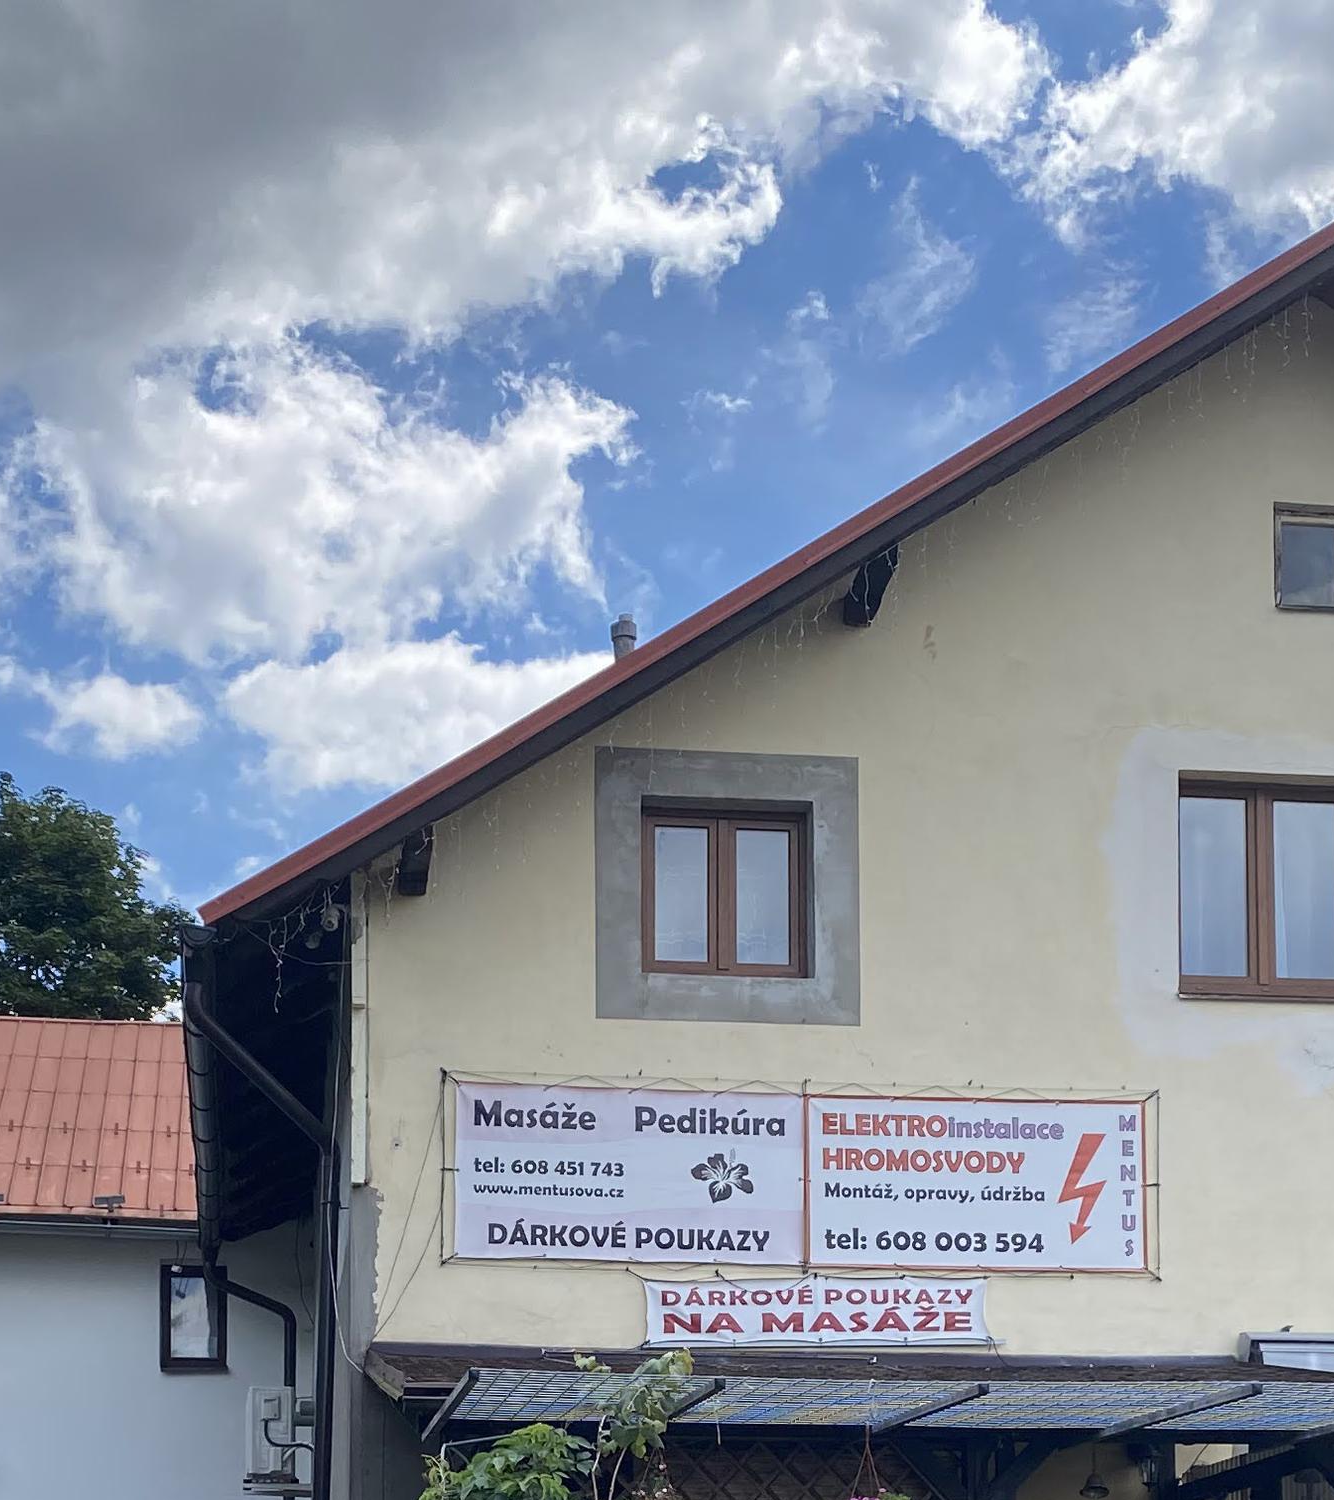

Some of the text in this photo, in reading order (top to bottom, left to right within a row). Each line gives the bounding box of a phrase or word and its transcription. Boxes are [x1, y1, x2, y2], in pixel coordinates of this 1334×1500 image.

[473, 1099, 786, 1137] Masáže Pedikúra
[822, 1112, 1064, 1140] ELEKTROinstalace
[473, 1157, 624, 1177] tel: 608 451 743
[822, 1148, 1025, 1174] HROMOSVODY
[473, 1184, 624, 1198] www.mentusova.cz
[824, 1182, 1045, 1204] Montáž, opravy, údržba
[1119, 1115, 1136, 1257] MENTUS
[488, 1218, 770, 1252] DÁRKOVÉ POUKAZY
[824, 1228, 1044, 1253] tel: 608 003 594
[661, 1285, 973, 1306] DÁRKOVÉ POUKAZY
[663, 1306, 973, 1334] NA MASÁŽE
